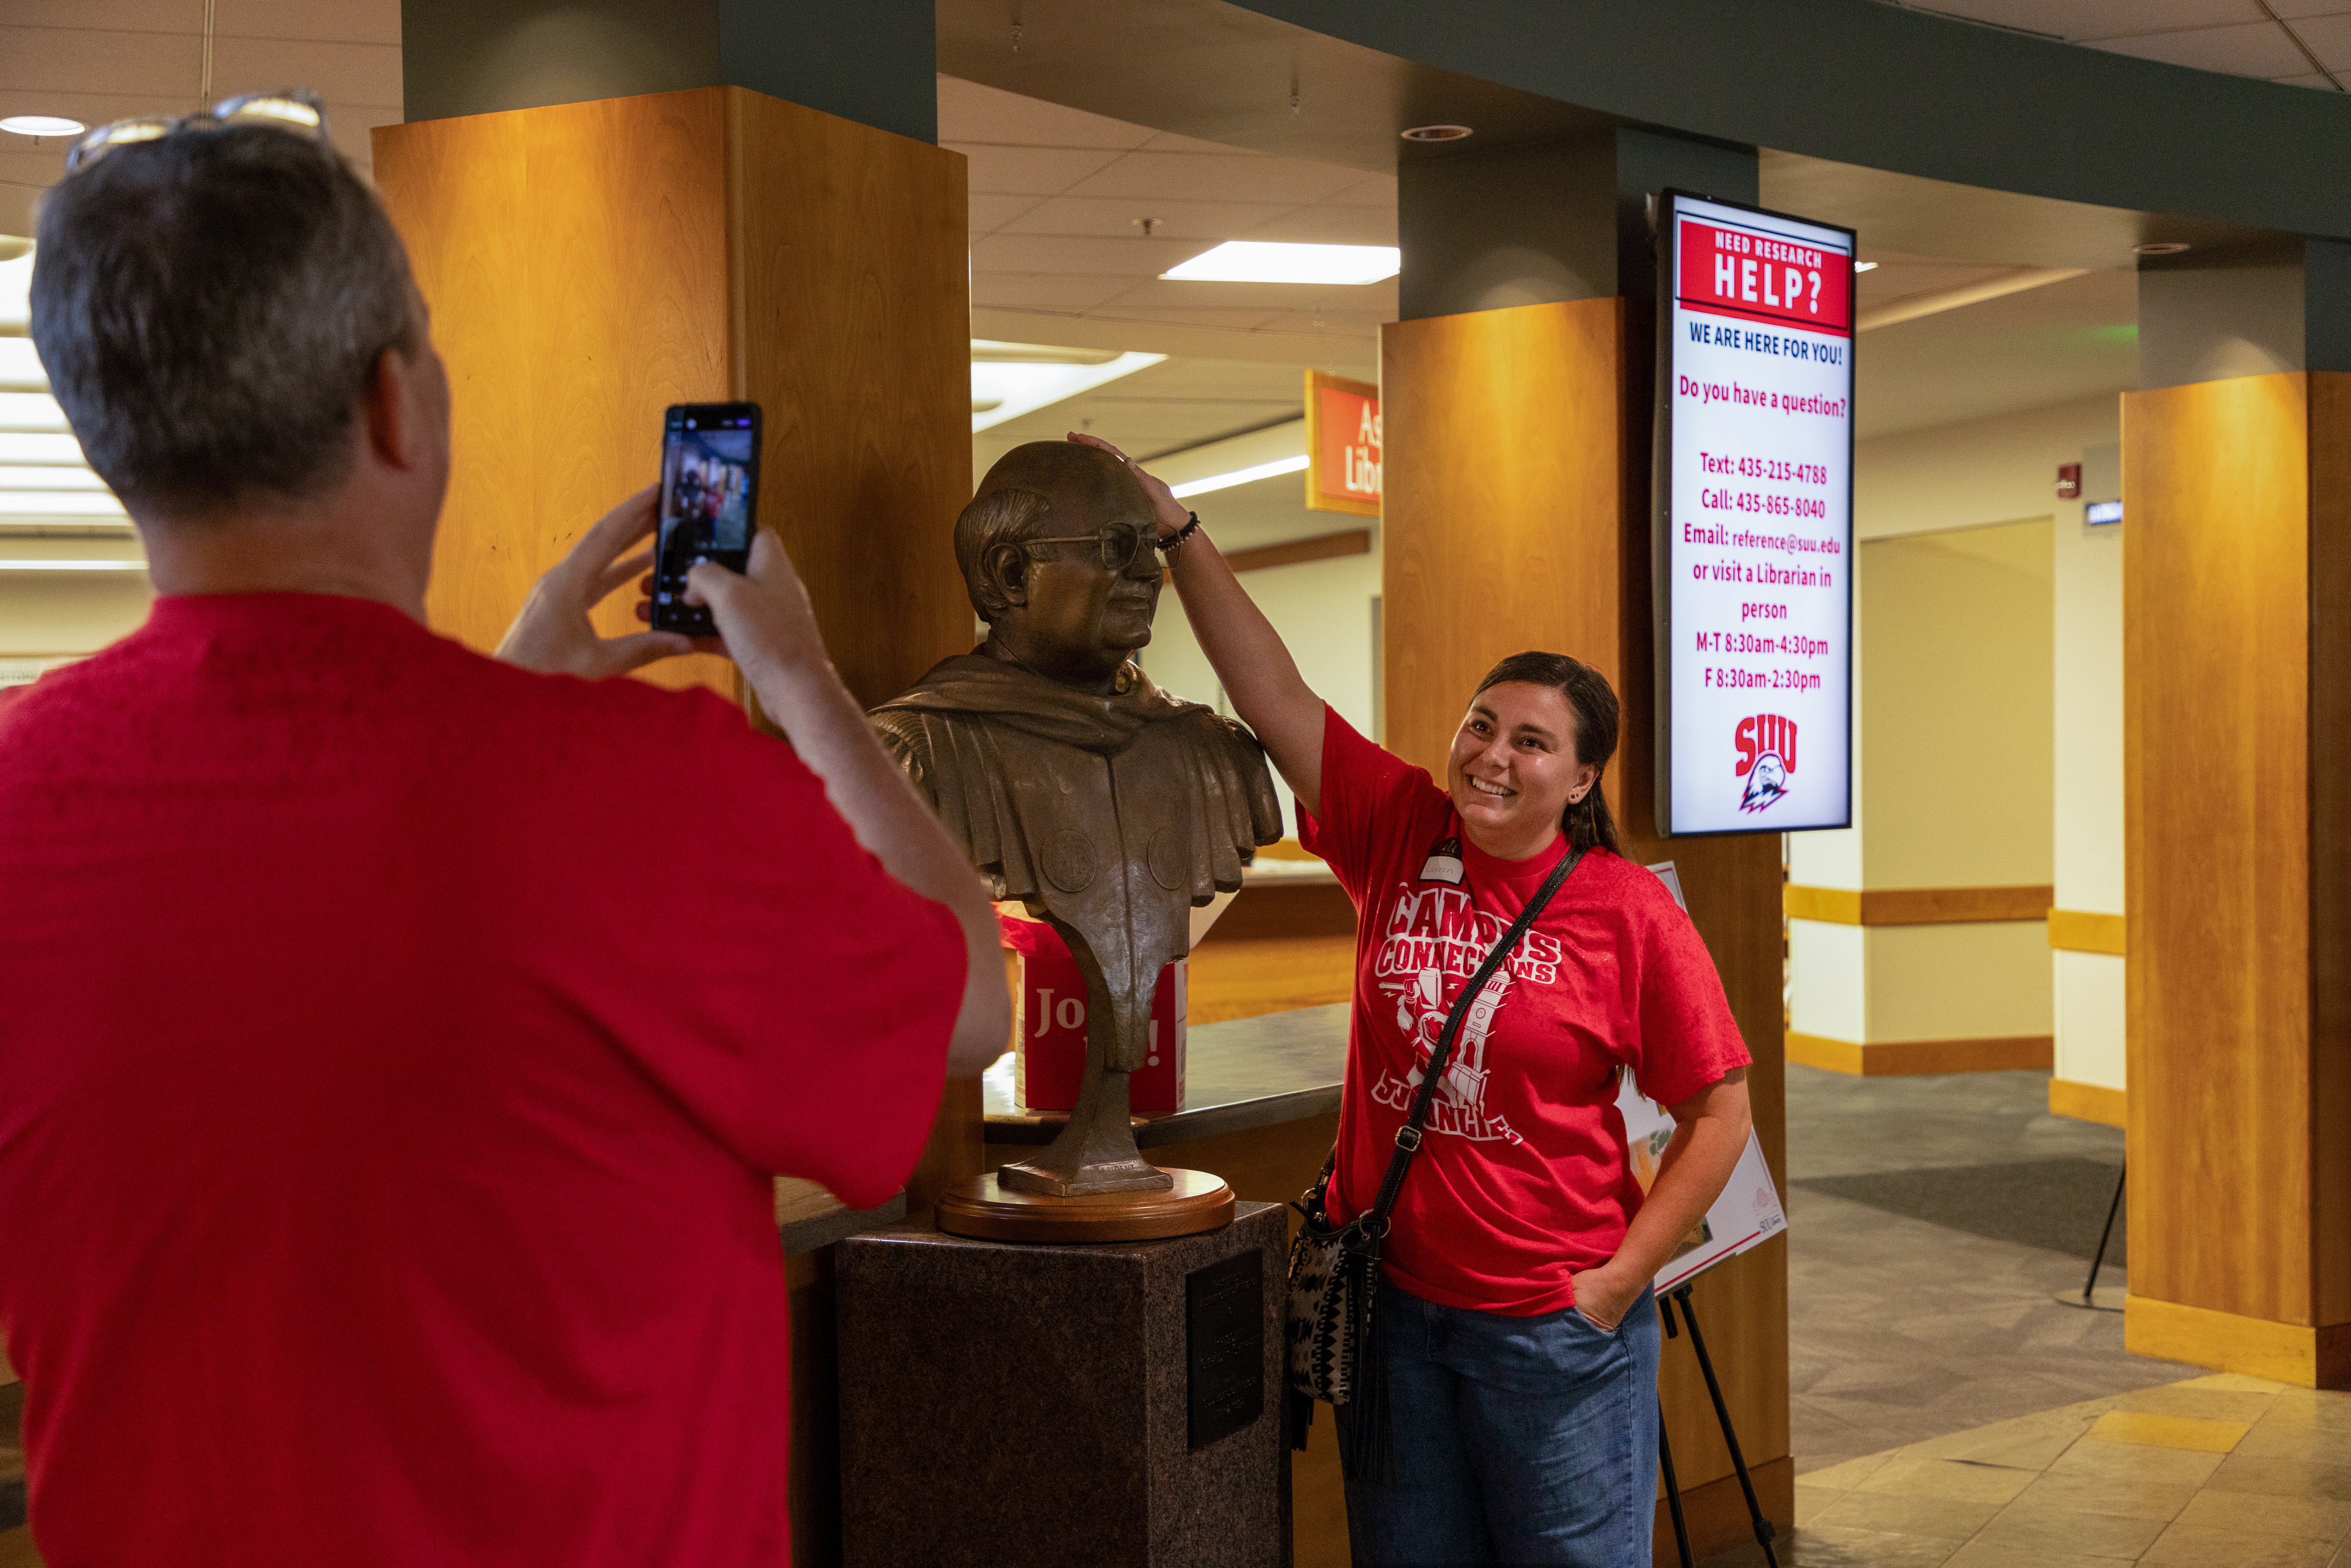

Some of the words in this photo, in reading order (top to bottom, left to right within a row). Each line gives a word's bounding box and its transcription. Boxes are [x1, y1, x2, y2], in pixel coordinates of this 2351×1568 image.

[1716, 231, 1750, 254] NEED
[1755, 239, 1822, 269] RESEARCH
[1714, 253, 1822, 314] HELP?
[1690, 321, 1710, 343] WE
[1714, 327, 1740, 349] ARE
[1745, 331, 1779, 355] HERE
[1784, 339, 1808, 360] FOR
[1813, 344, 1842, 365] YOU!
[1680, 375, 1698, 397] Do
[1704, 382, 1729, 404] you
[1734, 382, 1766, 407] have
[1771, 392, 1778, 407] a
[1782, 394, 1846, 418] question?
[1358, 400, 1381, 447] As
[1701, 452, 1734, 474] Text:
[1739, 458, 1827, 484] 435-215-4788
[1702, 489, 1732, 510] Call:
[1737, 493, 1825, 518] 435-865-8040
[1685, 523, 1728, 545] Email:
[1733, 530, 1840, 554] reference@suu.edu
[1693, 564, 1708, 580] or
[1713, 560, 1741, 581] visit
[1747, 568, 1752, 582] a
[1758, 564, 1816, 586] Librarian
[1820, 566, 1831, 587] in
[1742, 602, 1787, 621] person
[1697, 632, 1721, 652] M-T
[1725, 633, 1828, 659] 8:30am-4:30pm
[1706, 668, 1712, 687] F
[1717, 669, 1820, 692] 8:30am-2:30pm
[1736, 714, 1796, 776] SUU
[1376, 936, 1556, 985] CONNECONS
[1034, 988, 1085, 1038] Jo
